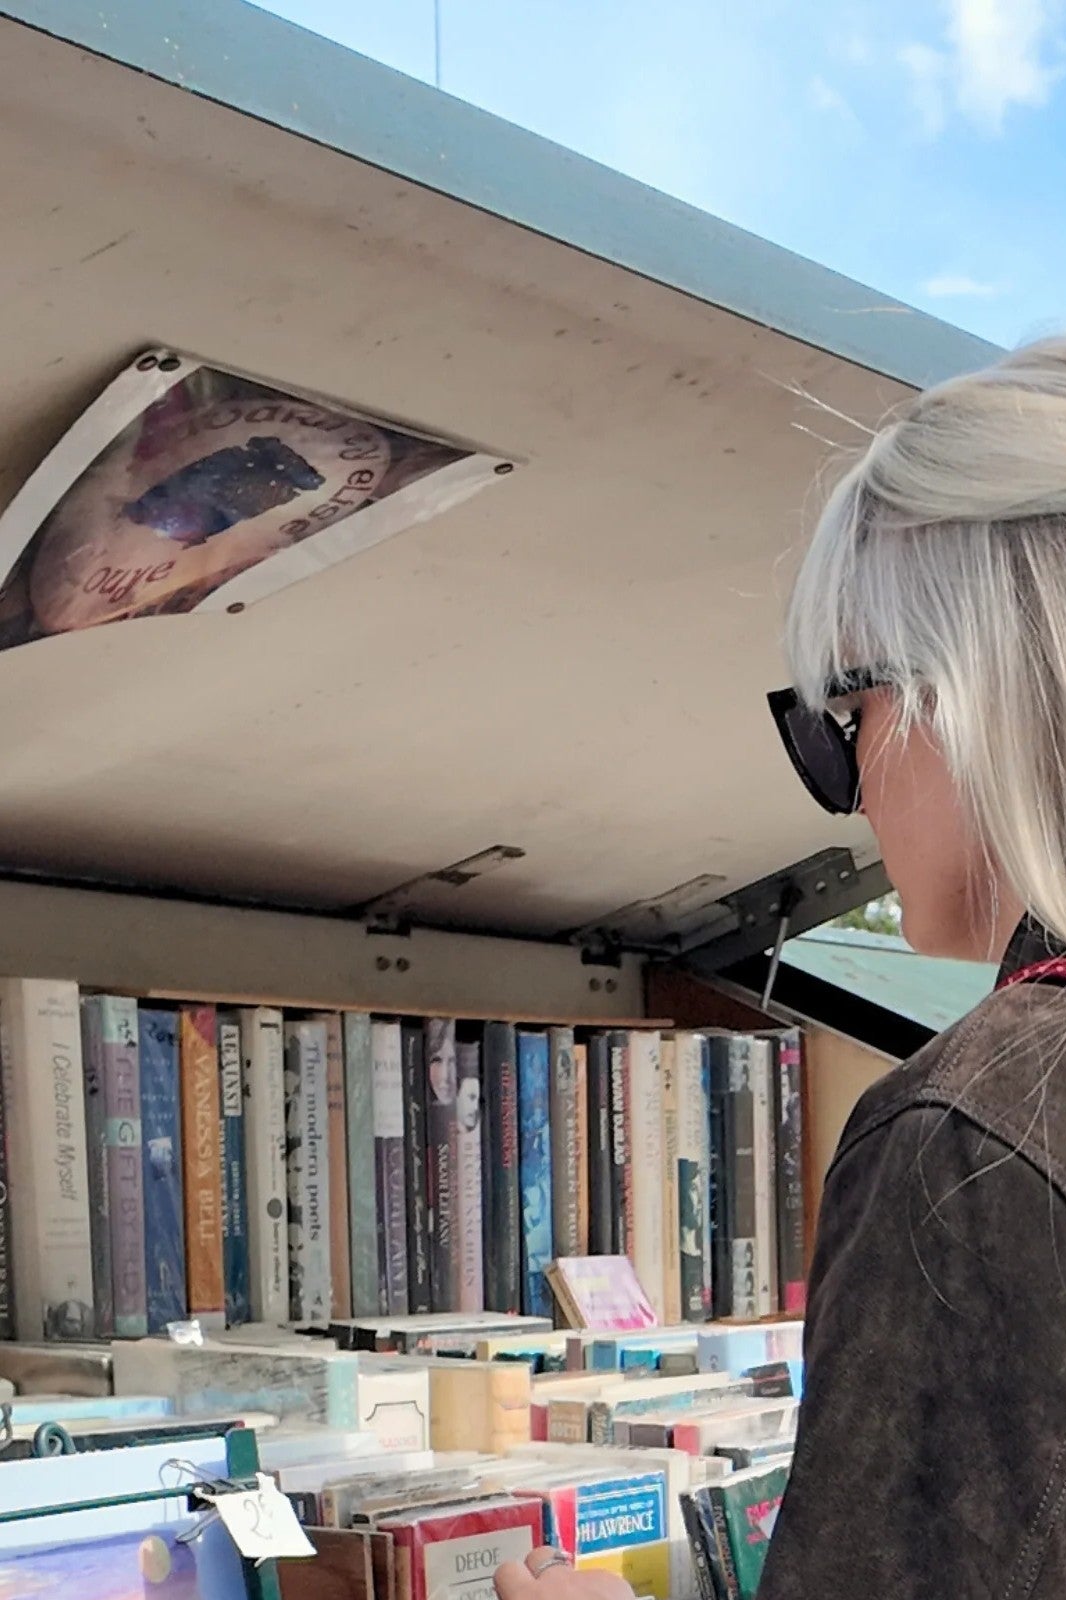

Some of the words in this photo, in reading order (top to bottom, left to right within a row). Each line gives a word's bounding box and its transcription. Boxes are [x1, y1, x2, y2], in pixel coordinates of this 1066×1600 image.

[223, 1032, 239, 1111] AGAINST
[306, 1041, 321, 1081] The
[52, 1056, 75, 1138] Celebrate
[193, 1055, 213, 1178] VANESSA
[118, 1121, 137, 1186] GIFT
[306, 1092, 323, 1177] modern
[55, 1144, 78, 1202] Myself
[121, 1199, 138, 1230] BY
[198, 1190, 216, 1247] BELL
[306, 1184, 321, 1241] poets
[592, 1510, 655, 1541] LAWRENCE
